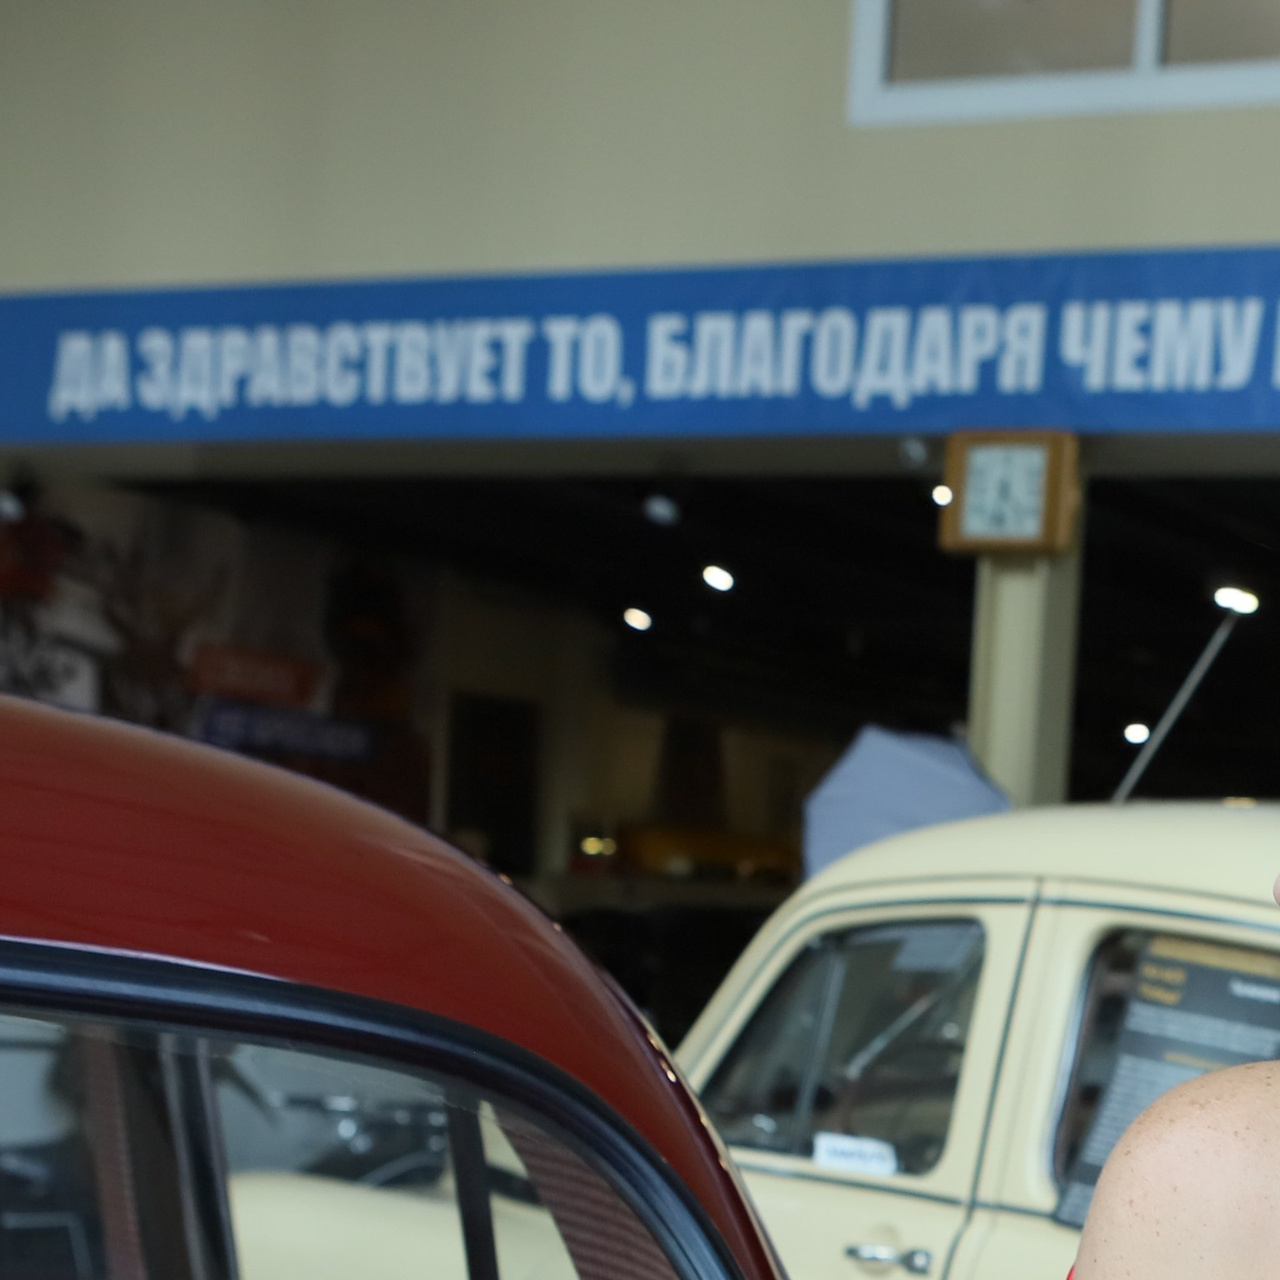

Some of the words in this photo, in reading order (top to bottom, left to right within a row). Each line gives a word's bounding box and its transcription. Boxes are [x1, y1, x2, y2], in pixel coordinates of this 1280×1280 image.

[48, 329, 132, 423] ДА
[137, 316, 534, 422] ЗДРАВСТВУЕТ
[542, 312, 636, 411] ТО,
[645, 303, 1048, 412] БЛАГОДАРЯ
[1059, 298, 1264, 395] ЧЕМУ
